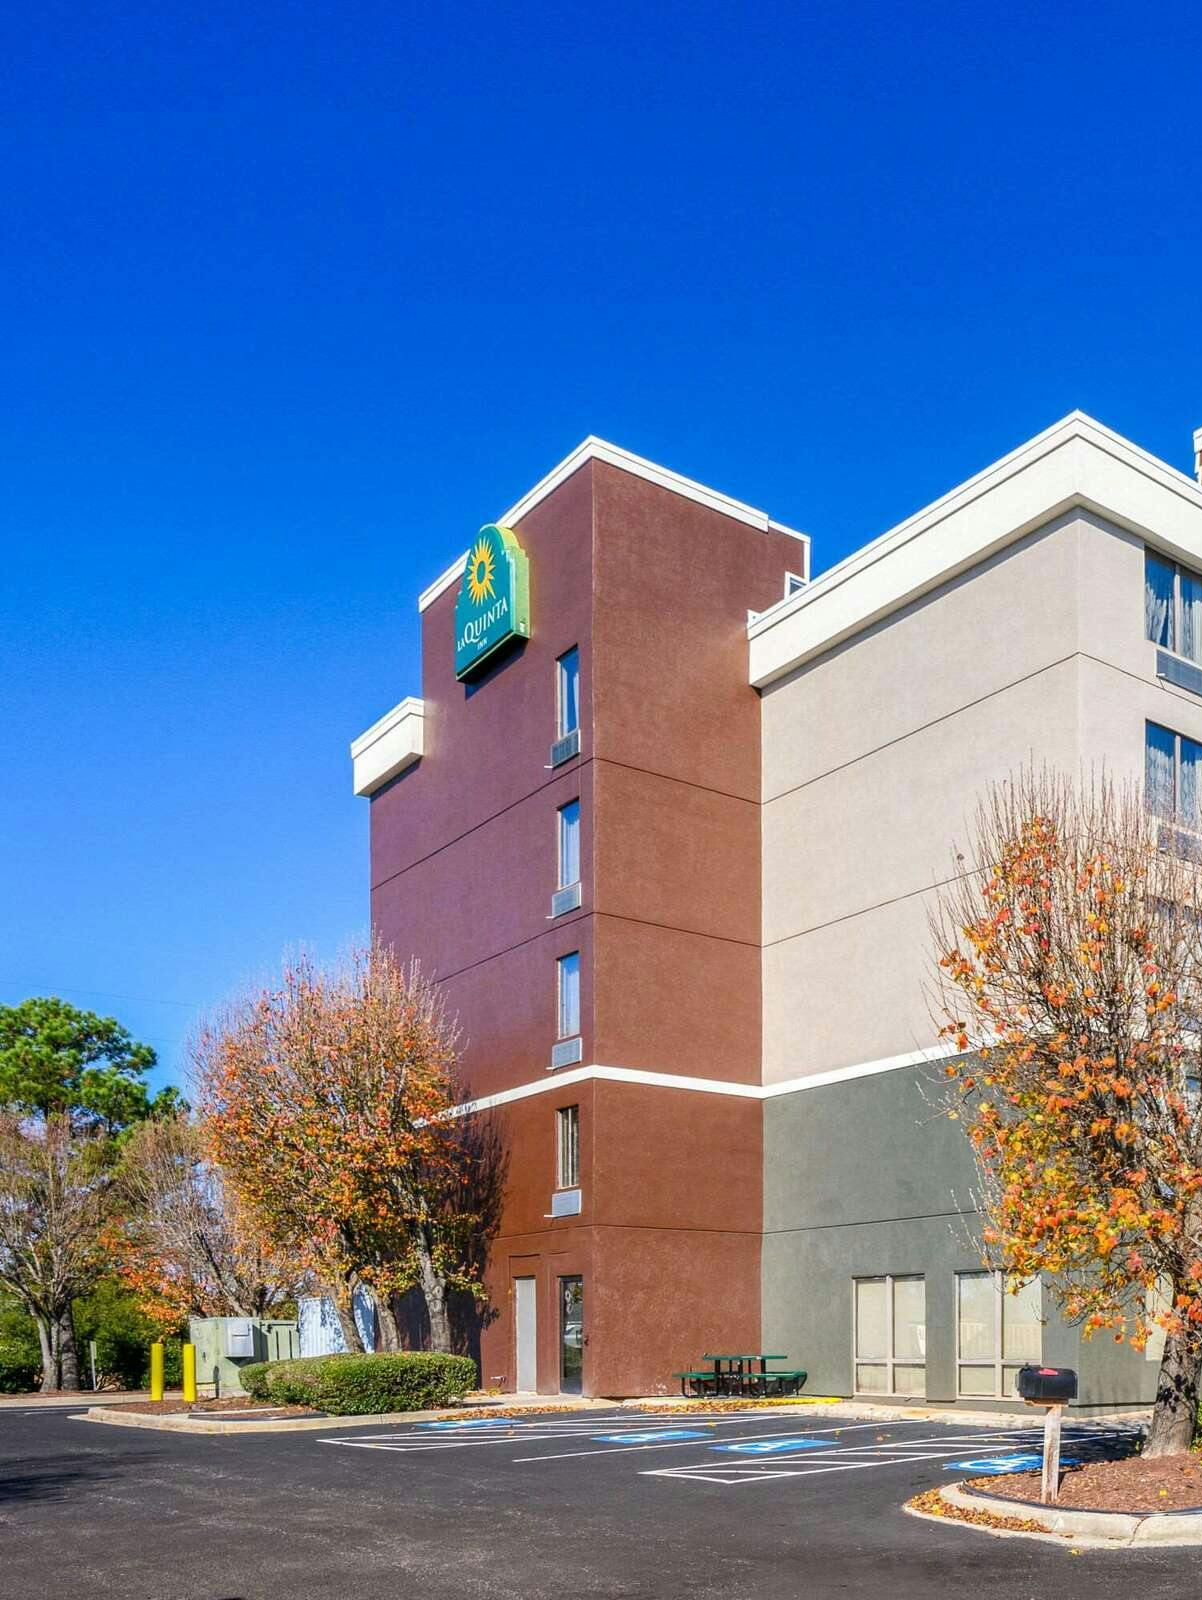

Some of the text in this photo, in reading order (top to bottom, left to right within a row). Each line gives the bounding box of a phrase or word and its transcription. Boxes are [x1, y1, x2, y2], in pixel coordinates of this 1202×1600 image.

[457, 595, 508, 652] LA QUINTA
[477, 637, 488, 651] INN
